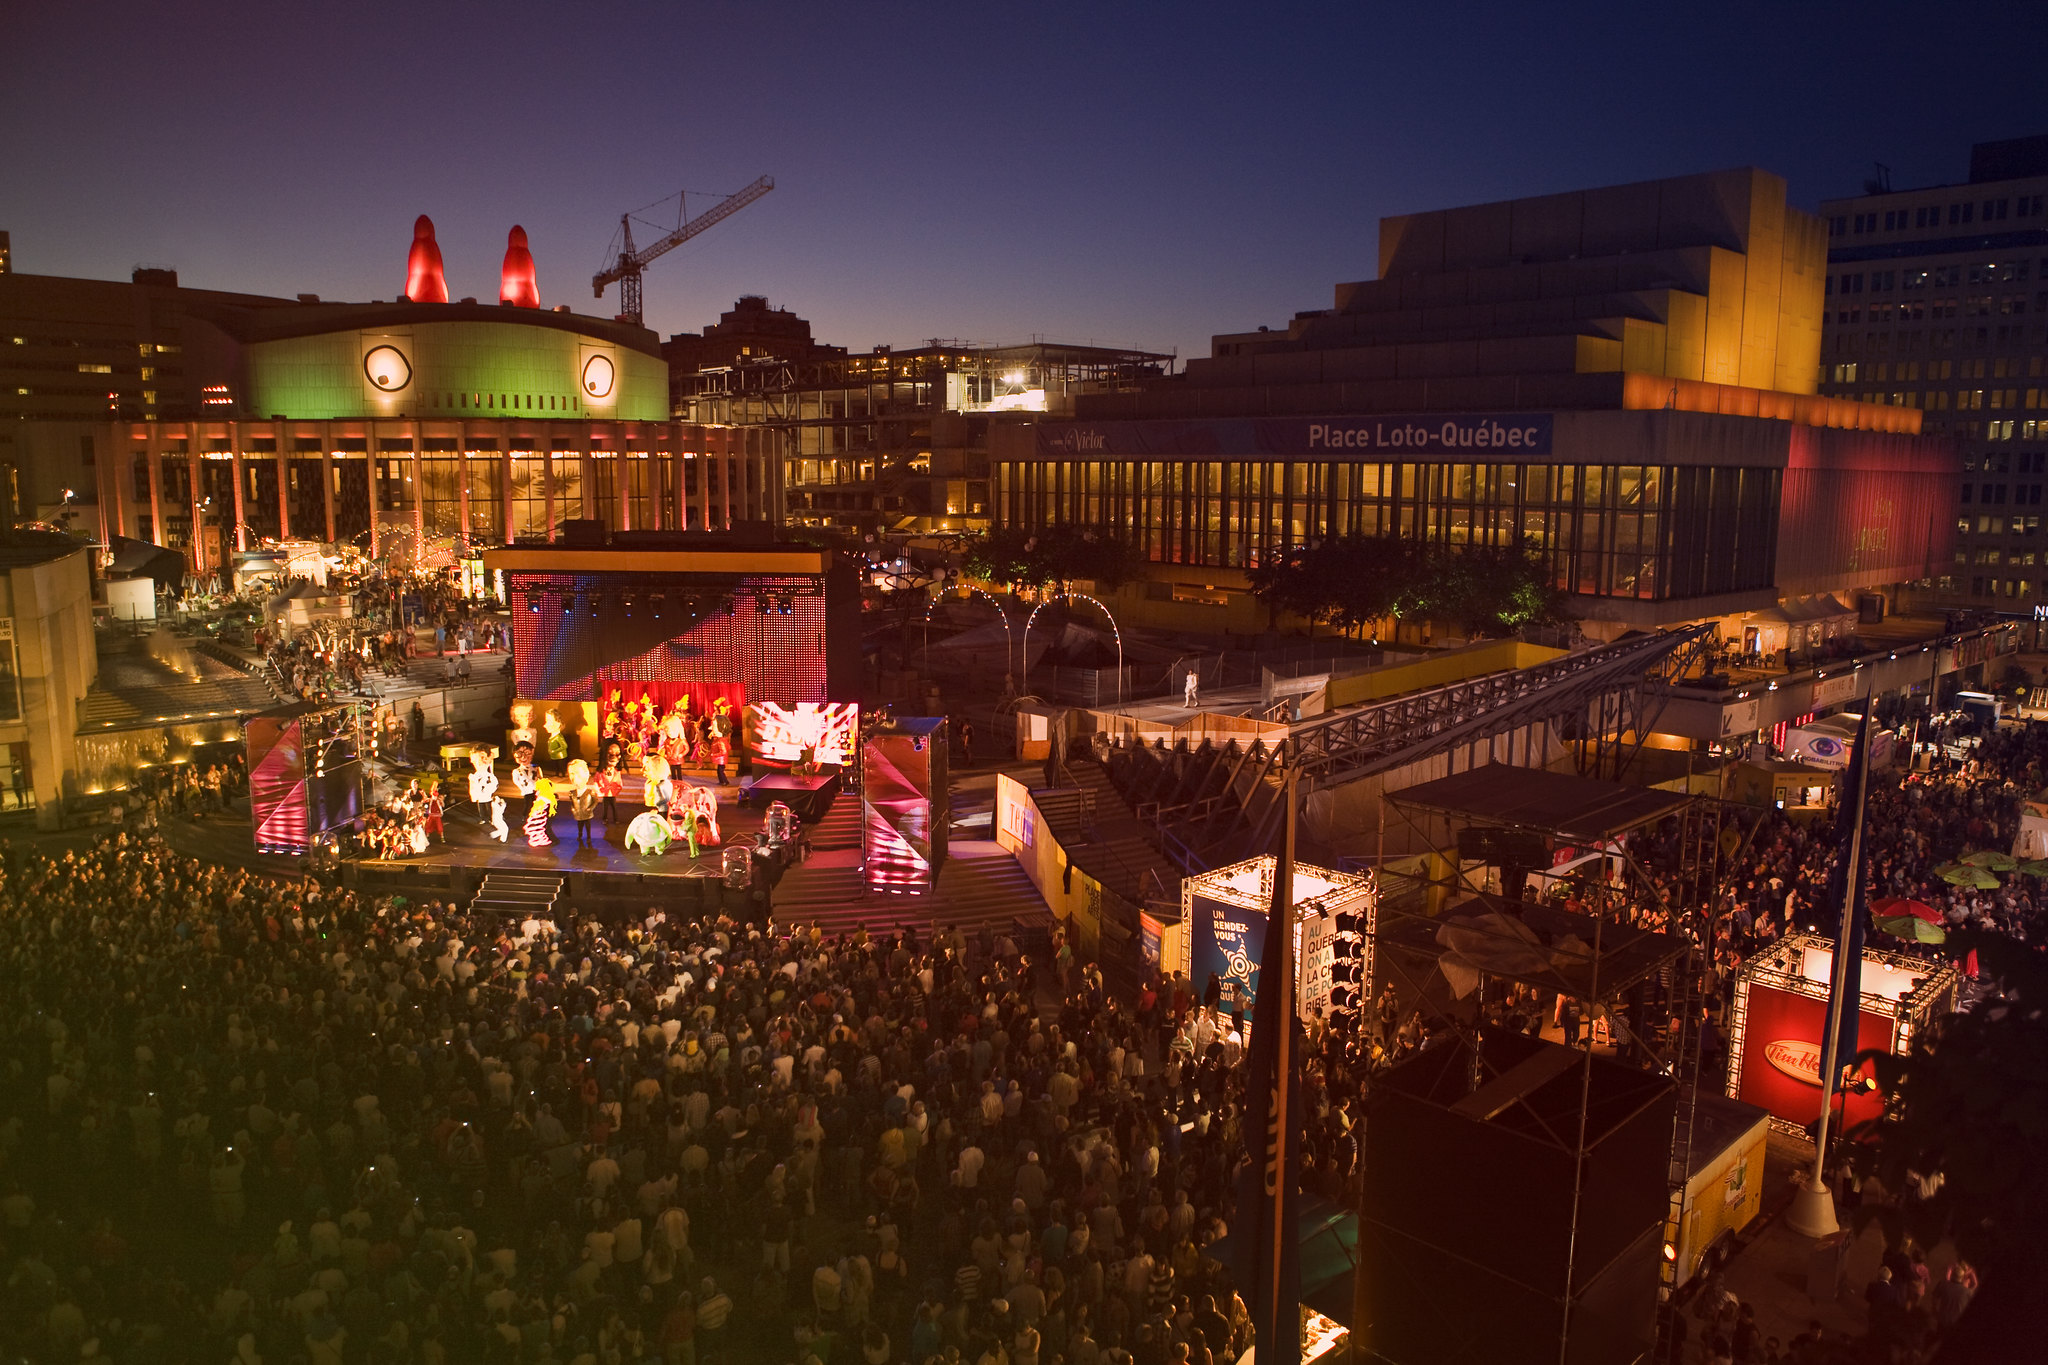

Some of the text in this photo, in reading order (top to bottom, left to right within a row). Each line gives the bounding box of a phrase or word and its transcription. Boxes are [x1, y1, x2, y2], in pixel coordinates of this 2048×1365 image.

[1064, 427, 1105, 453] Victor
[1309, 419, 1538, 448] Place Loto-Québec
[1212, 910, 1225, 920] UN
[1213, 920, 1249, 933] RENDEZ-
[1308, 924, 1322, 940] AU
[1213, 930, 1236, 942] VOUS
[1307, 950, 1330, 970] ON A
[1306, 969, 1319, 985] LA
[1306, 984, 1319, 1000] DE
[1763, 1043, 1798, 1066] Tim
